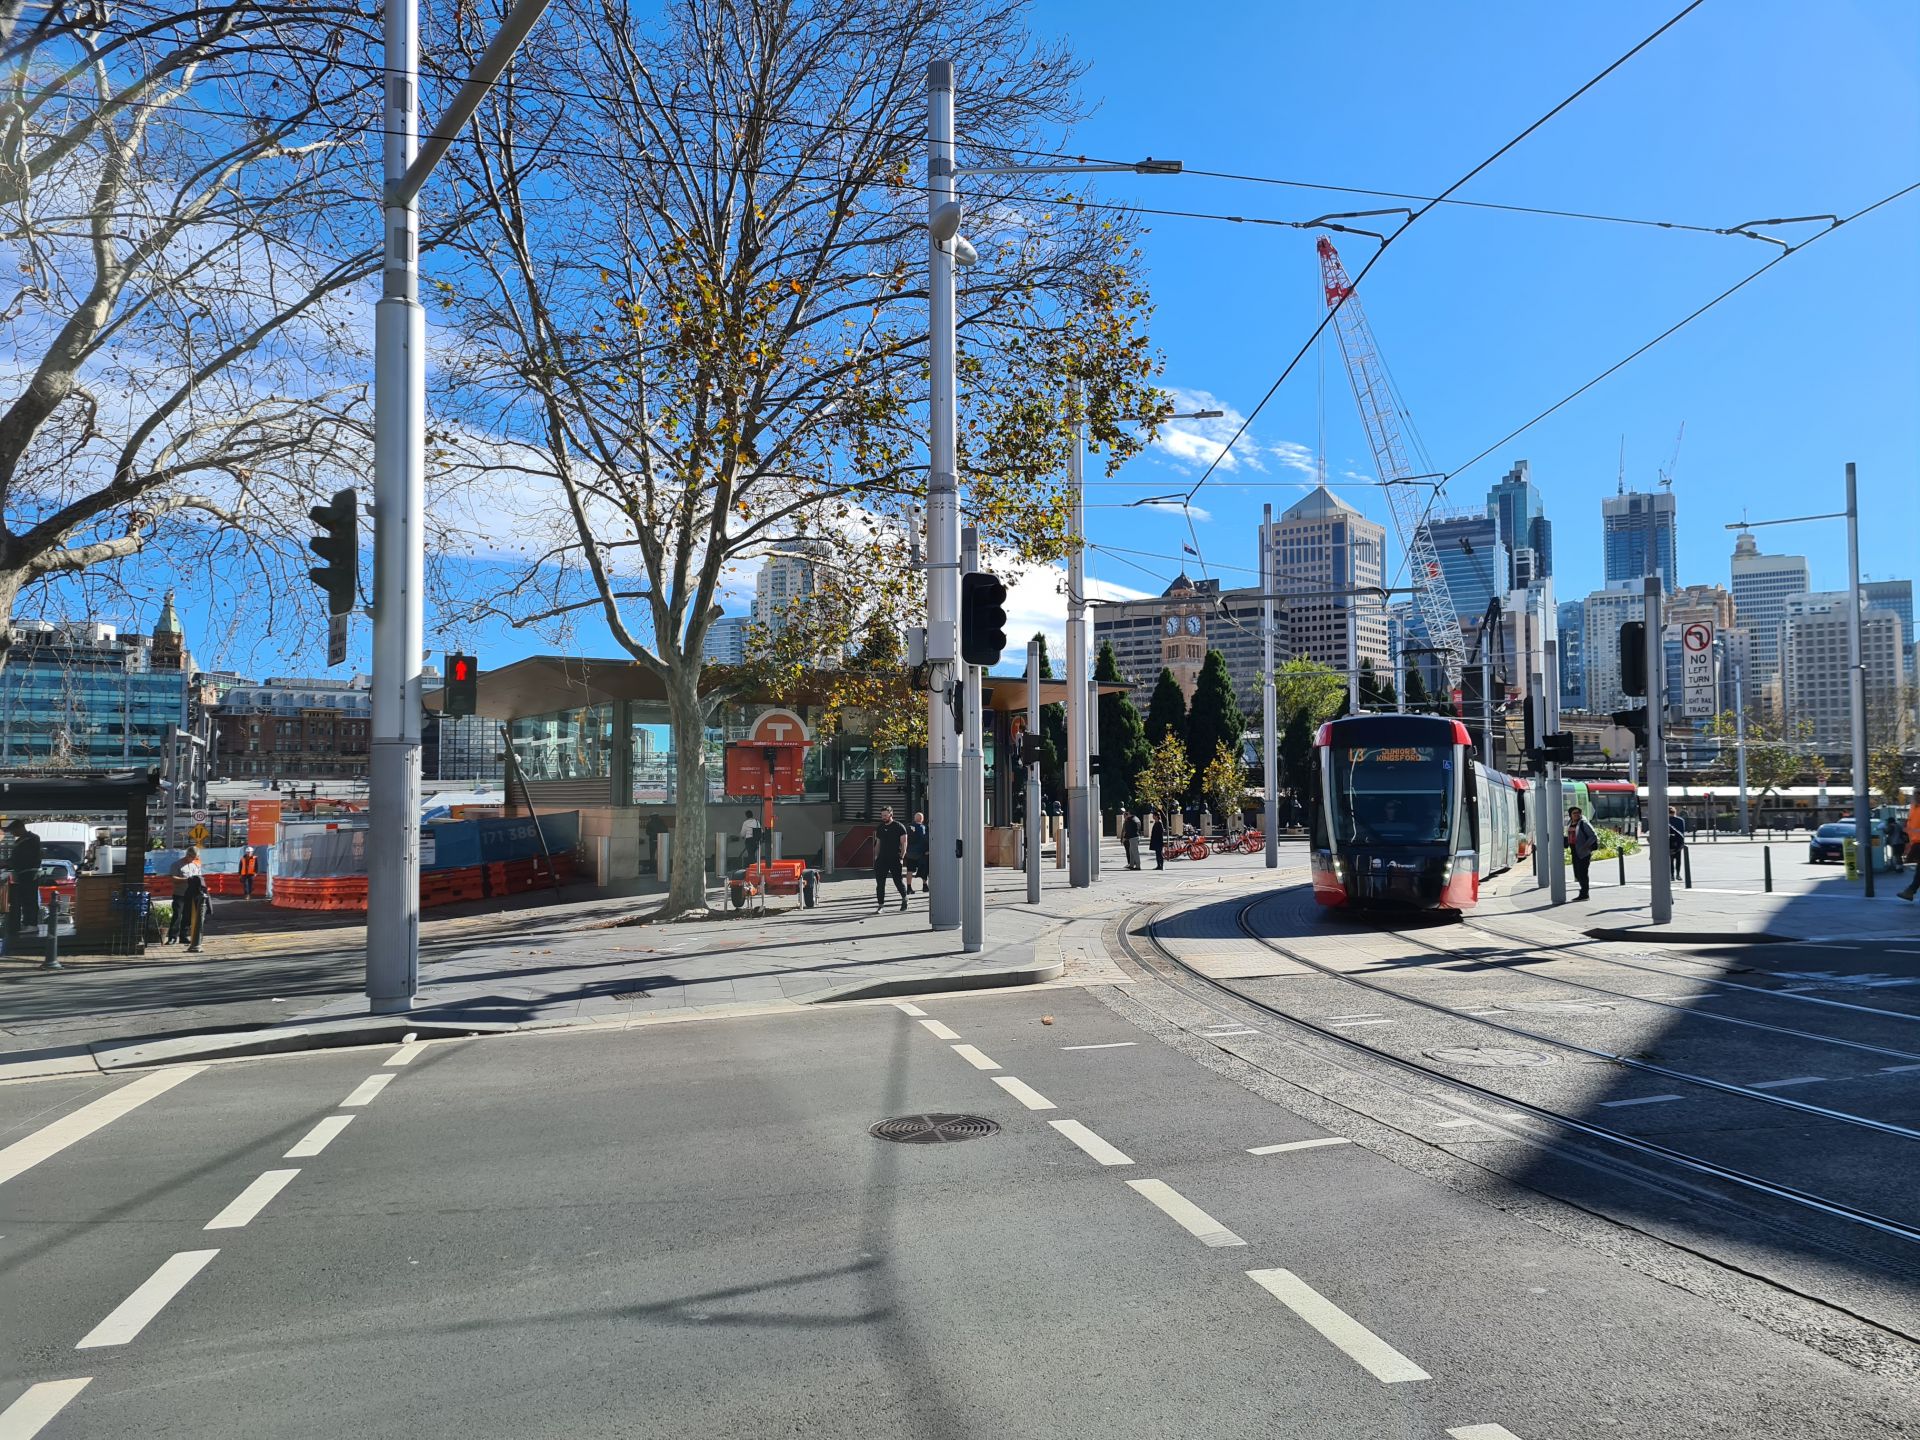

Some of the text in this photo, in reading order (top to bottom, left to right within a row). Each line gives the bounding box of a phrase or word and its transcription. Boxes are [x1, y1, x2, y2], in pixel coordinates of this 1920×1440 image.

[1690, 655, 1707, 664] NO
[1689, 666, 1707, 674] LEFT
[767, 723, 792, 741] T
[1376, 754, 1420, 762] KINGSFORD
[508, 825, 537, 840] 386
